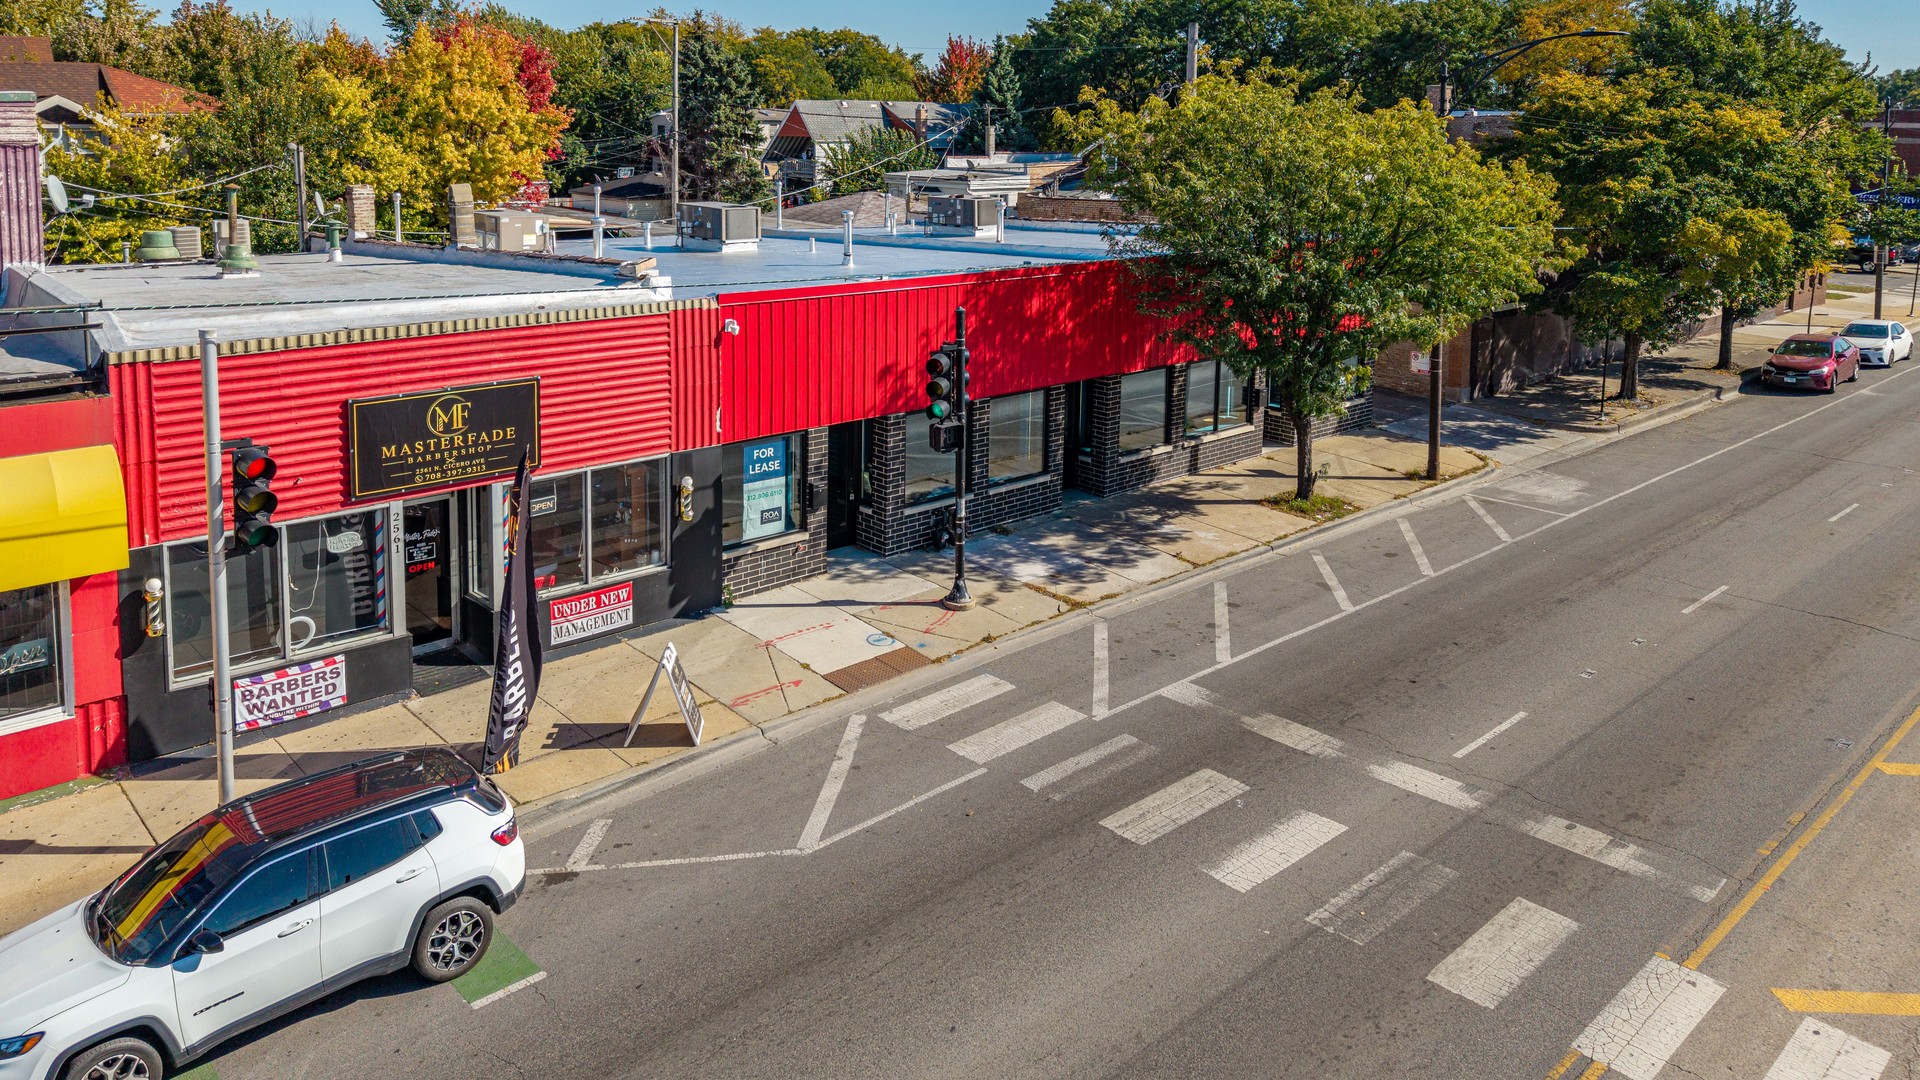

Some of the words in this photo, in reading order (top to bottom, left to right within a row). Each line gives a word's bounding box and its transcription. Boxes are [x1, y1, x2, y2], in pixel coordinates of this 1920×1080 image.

[382, 427, 516, 458] MASTERFADE
[407, 444, 492, 464] BARBERSHOP
[753, 447, 774, 460] FOR
[415, 466, 432, 475] 2561
[443, 460, 470, 470] CICERO
[472, 458, 485, 466] AVE
[425, 465, 486, 481] 708-397-9313
[749, 460, 781, 474] LEASE
[531, 501, 554, 512] OPEN
[393, 512, 401, 553] 2561
[408, 561, 435, 573] OPEN
[553, 598, 597, 618] UNDER
[600, 588, 630, 606] NEW
[553, 608, 631, 640] MANAGEMENT
[241, 666, 341, 703] BARBERS
[245, 682, 338, 715] WANTED
[295, 701, 320, 712] WITHIN
